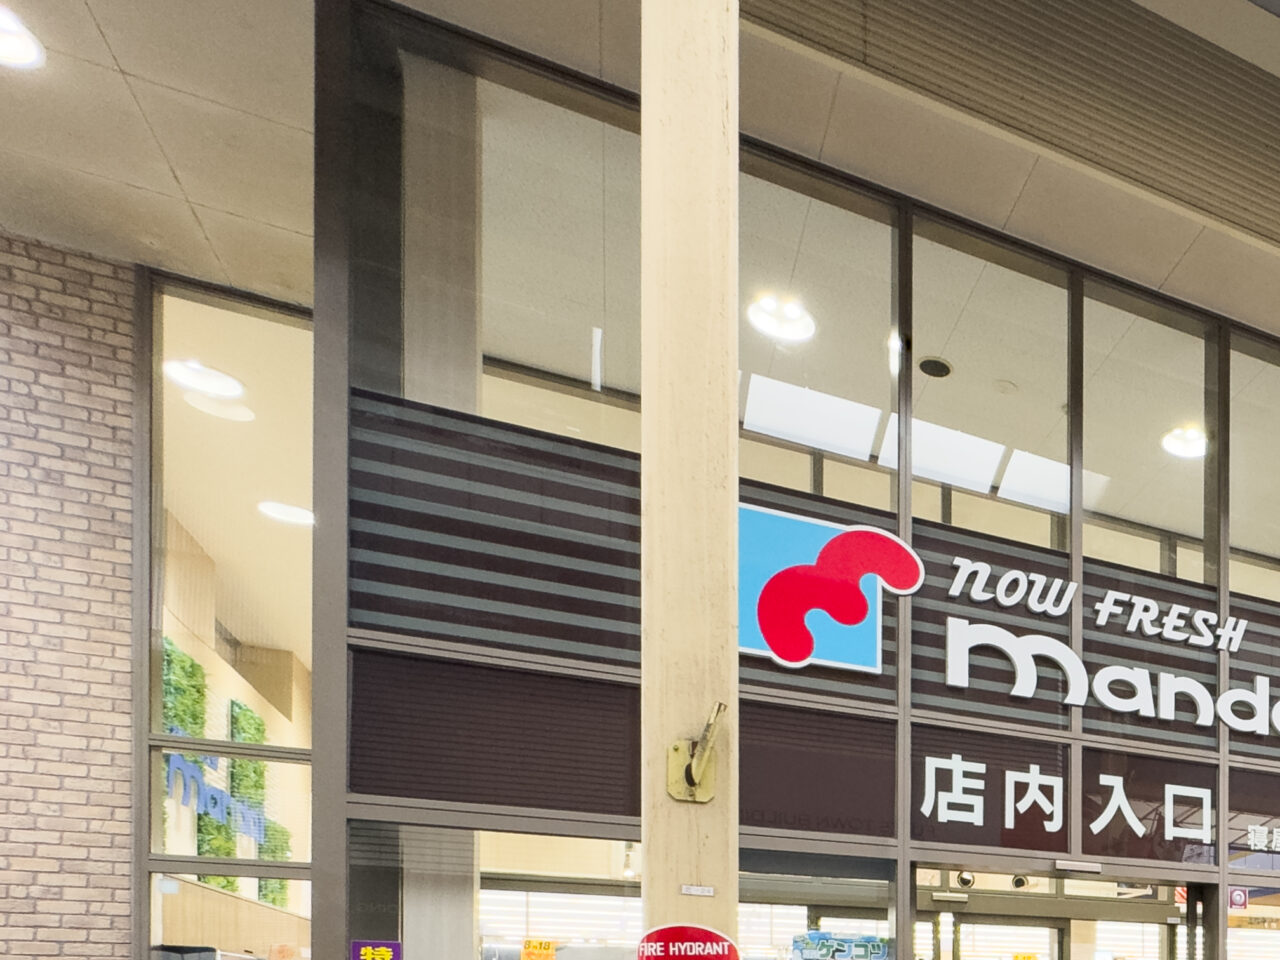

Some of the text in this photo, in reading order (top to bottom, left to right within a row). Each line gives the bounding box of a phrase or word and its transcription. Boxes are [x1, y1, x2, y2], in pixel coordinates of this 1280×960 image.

[1094, 590, 1248, 652] FRESH
[920, 753, 1212, 844] 店内入口
[669, 941, 730, 956] HYDRANT
